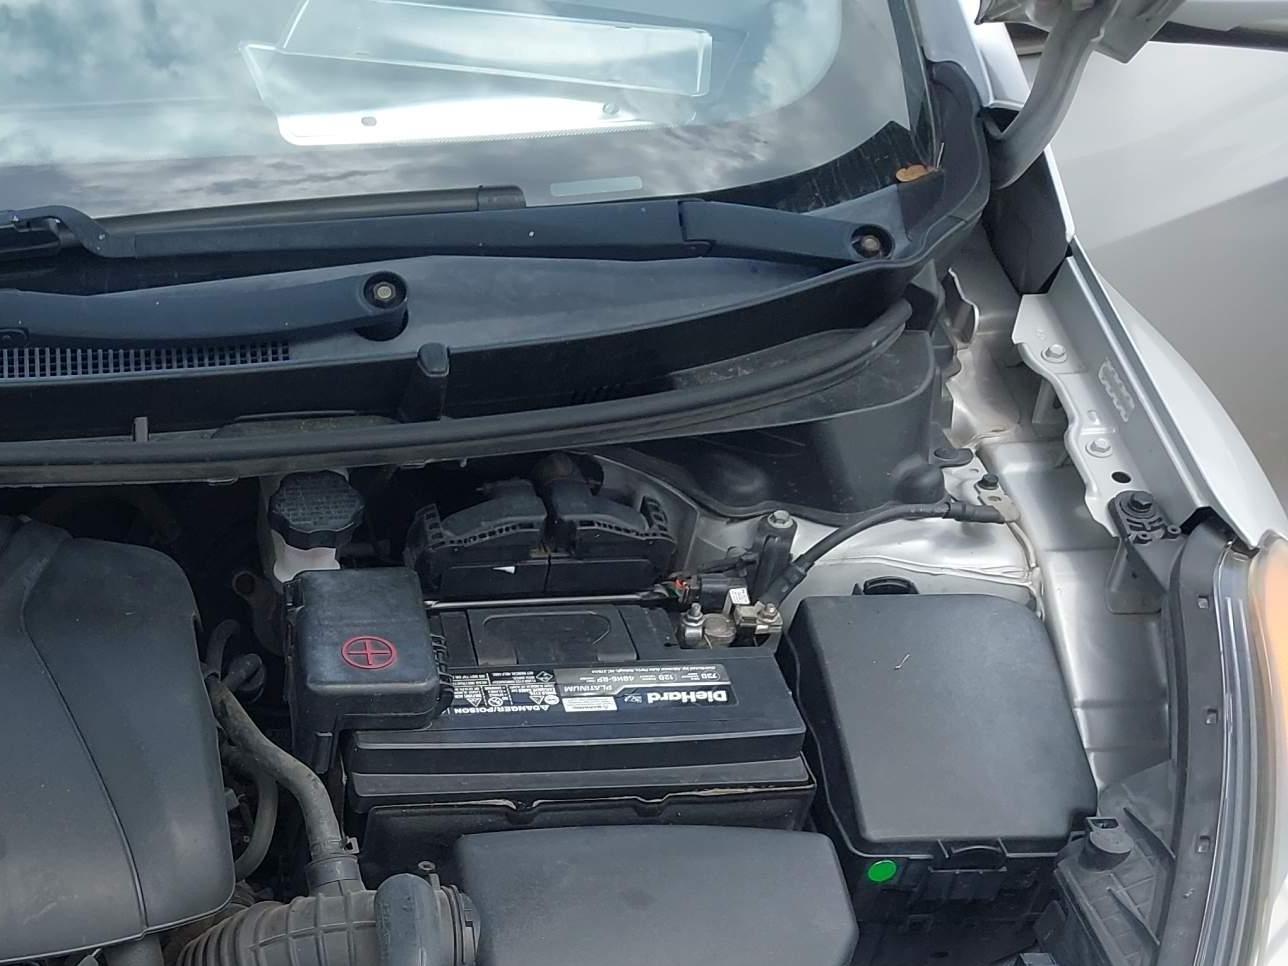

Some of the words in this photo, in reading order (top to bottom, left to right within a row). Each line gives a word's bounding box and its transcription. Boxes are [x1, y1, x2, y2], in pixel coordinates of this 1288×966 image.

[563, 684, 613, 693] PLATINUM
[647, 690, 728, 704] DieHard
[454, 705, 541, 714] DANGER/POISON
